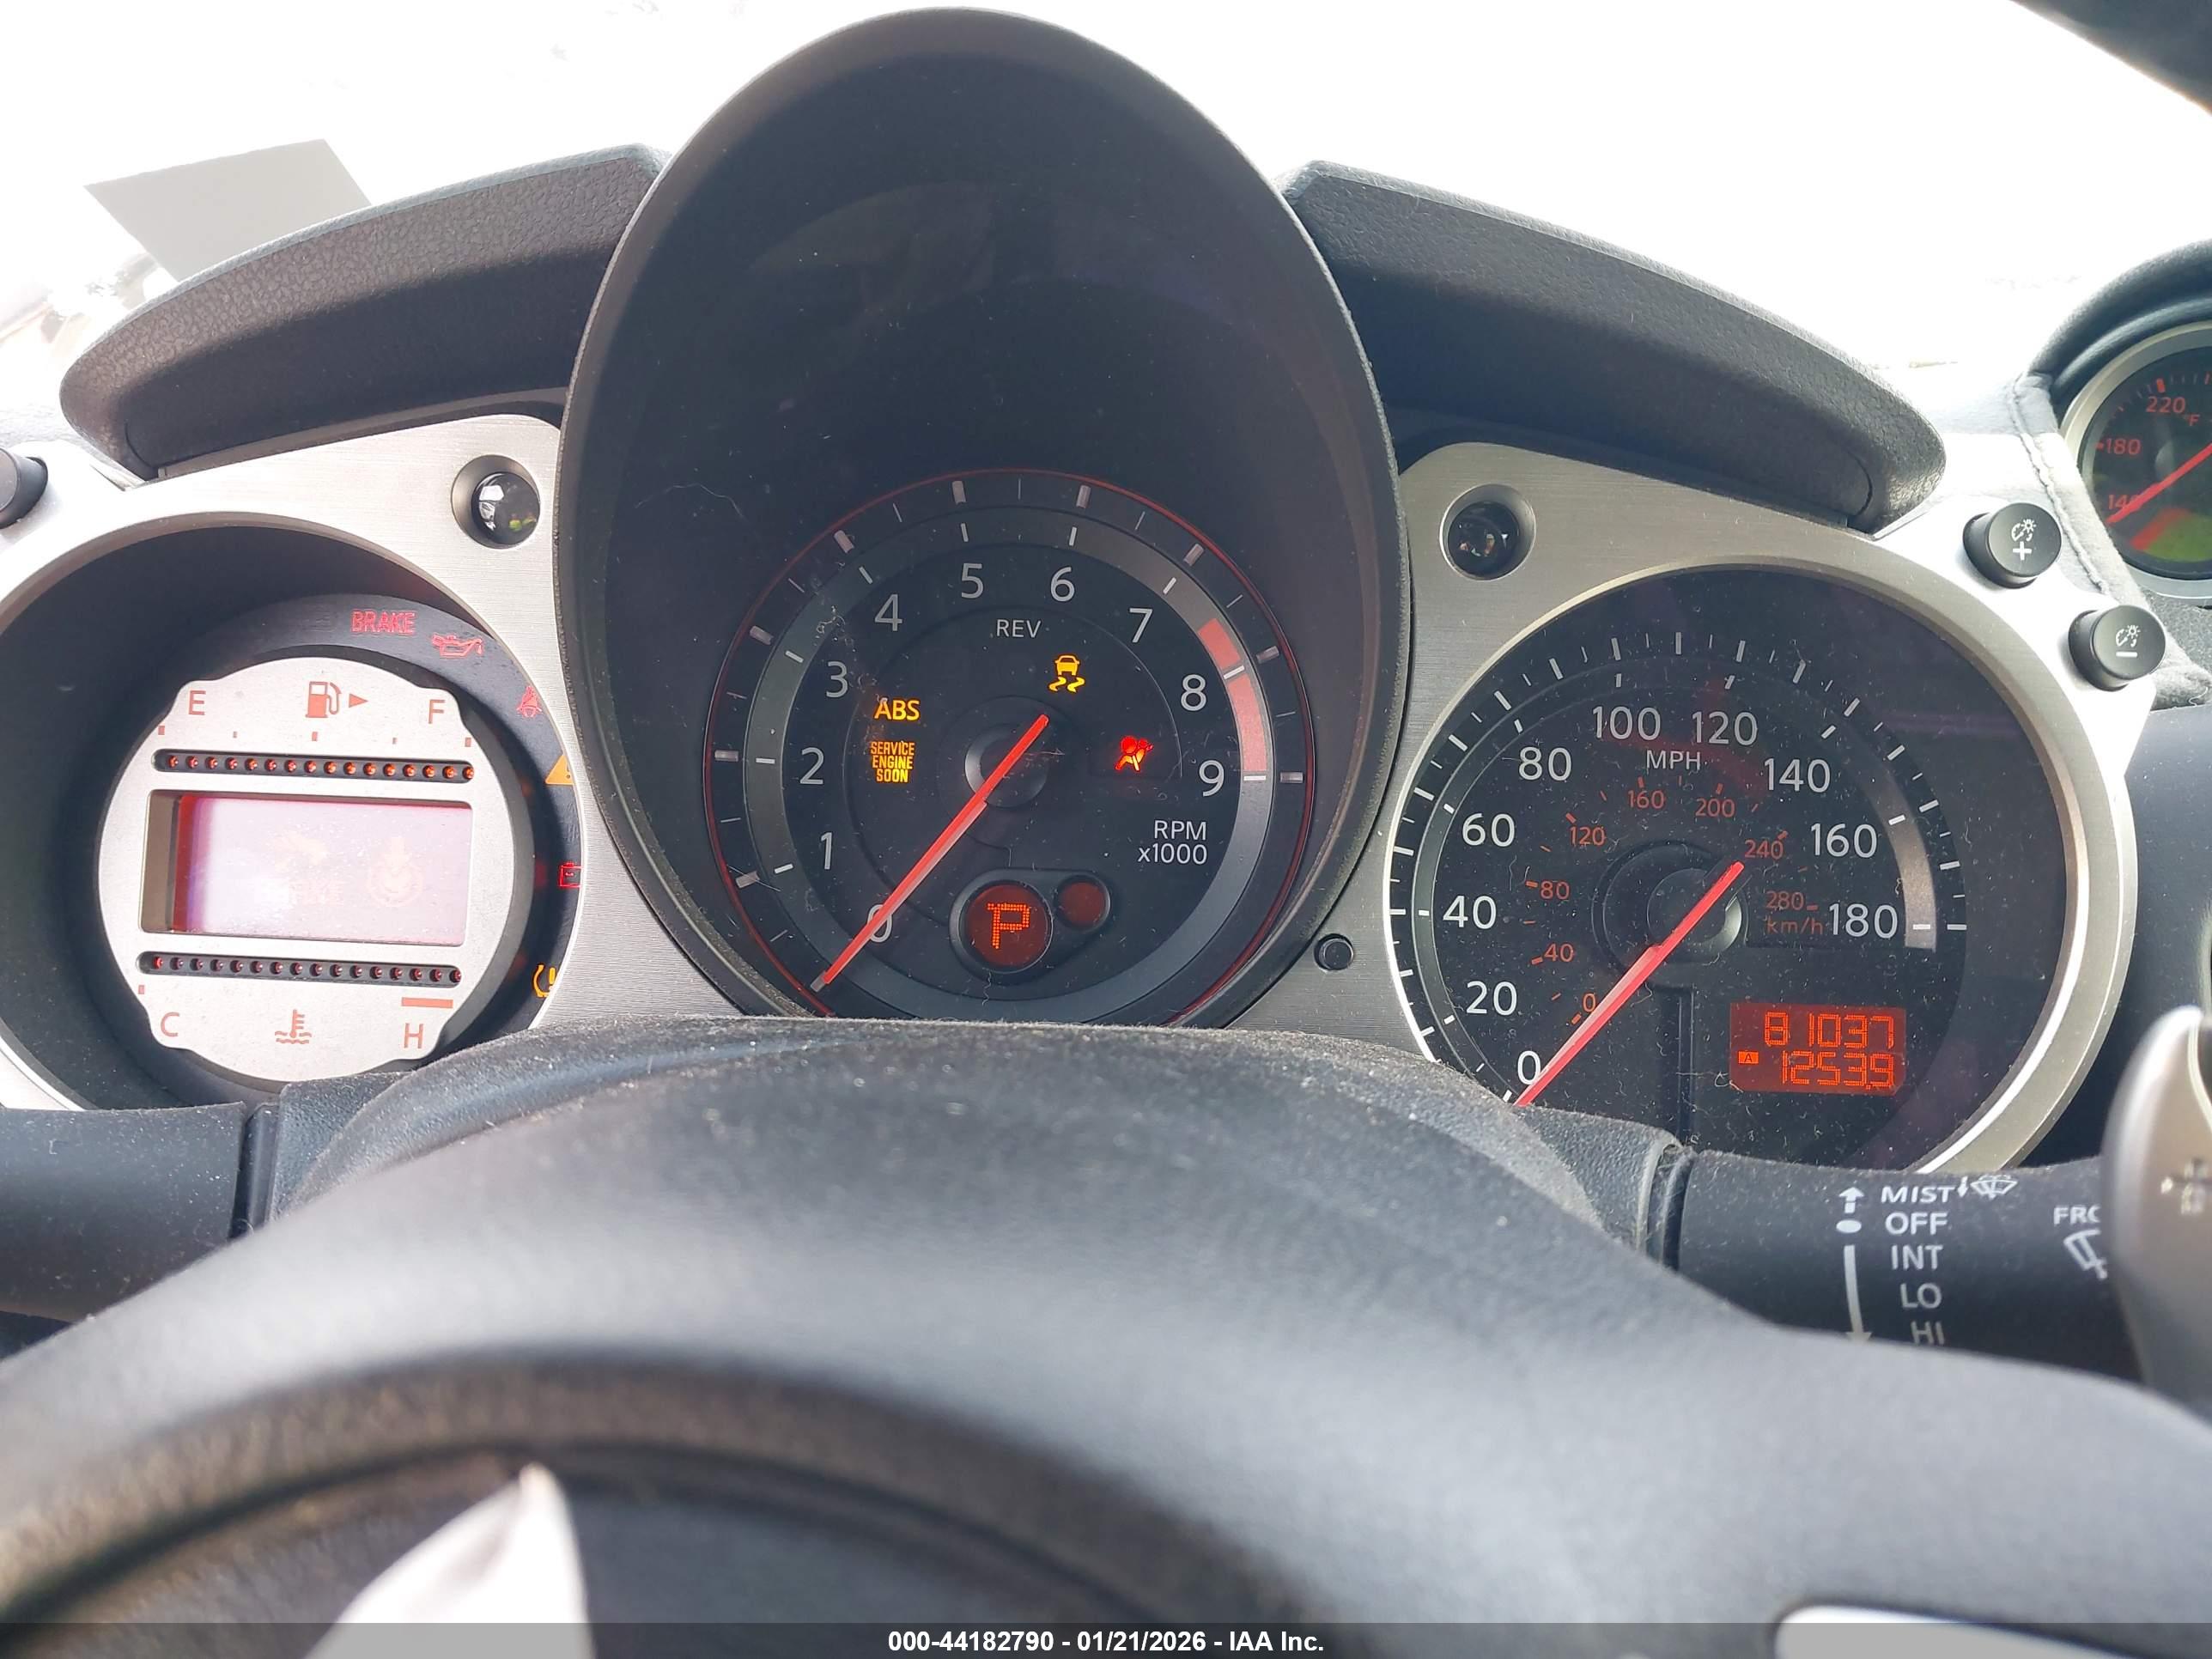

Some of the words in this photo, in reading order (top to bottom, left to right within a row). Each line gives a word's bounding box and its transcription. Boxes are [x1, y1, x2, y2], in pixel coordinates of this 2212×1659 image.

[2147, 397, 2185, 413] 220
[2106, 439, 2142, 454] 180
[961, 563, 984, 599] 5
[1050, 567, 1074, 602] 6
[350, 609, 417, 635] BRAKE
[874, 594, 902, 631] 4
[1128, 607, 1153, 643] 7
[996, 619, 1042, 638] REV
[826, 661, 848, 697] 3
[189, 690, 206, 716] E
[1182, 674, 1206, 711] 8
[429, 699, 445, 724] F
[874, 697, 921, 720] ABS
[1593, 707, 1661, 741] 100
[1692, 712, 1759, 746] 120
[870, 741, 915, 756] SERVICE
[1646, 750, 1701, 771] MPH
[801, 747, 824, 785] 2
[872, 755, 914, 769] ENGINE
[1518, 746, 1572, 781] 80
[876, 769, 909, 783] SOON
[1199, 759, 1224, 795] 9
[1765, 758, 1831, 793] 140
[1628, 790, 1666, 810] 160
[1695, 799, 1735, 818] 200
[1153, 820, 1206, 841] RPM
[1462, 813, 1516, 848] 60
[1570, 826, 1606, 847] 120
[1811, 823, 1877, 859] 160
[819, 832, 833, 869] 1
[1138, 843, 1207, 864] x1000
[1744, 839, 1784, 860] 240
[1540, 880, 1570, 900] 80
[1765, 890, 1805, 911] 280
[1443, 895, 1497, 929] 40
[1829, 902, 1898, 939] 180
[988, 902, 1030, 948] P
[1766, 916, 1823, 935] km/h
[1544, 944, 1574, 962] 40
[1466, 981, 1517, 1016] 20
[1582, 994, 1596, 1012] 0
[161, 1012, 179, 1037] C
[404, 1023, 423, 1049] H
[1765, 1012, 1894, 1049] 81037
[1517, 1050, 1542, 1085] 0
[1881, 1184, 1957, 1204] MIST
[1885, 1212, 1948, 1236] OFF
[1892, 1245, 1943, 1270] INT
[1900, 1283, 1942, 1310] LO
[1911, 1321, 1945, 1346] HI
